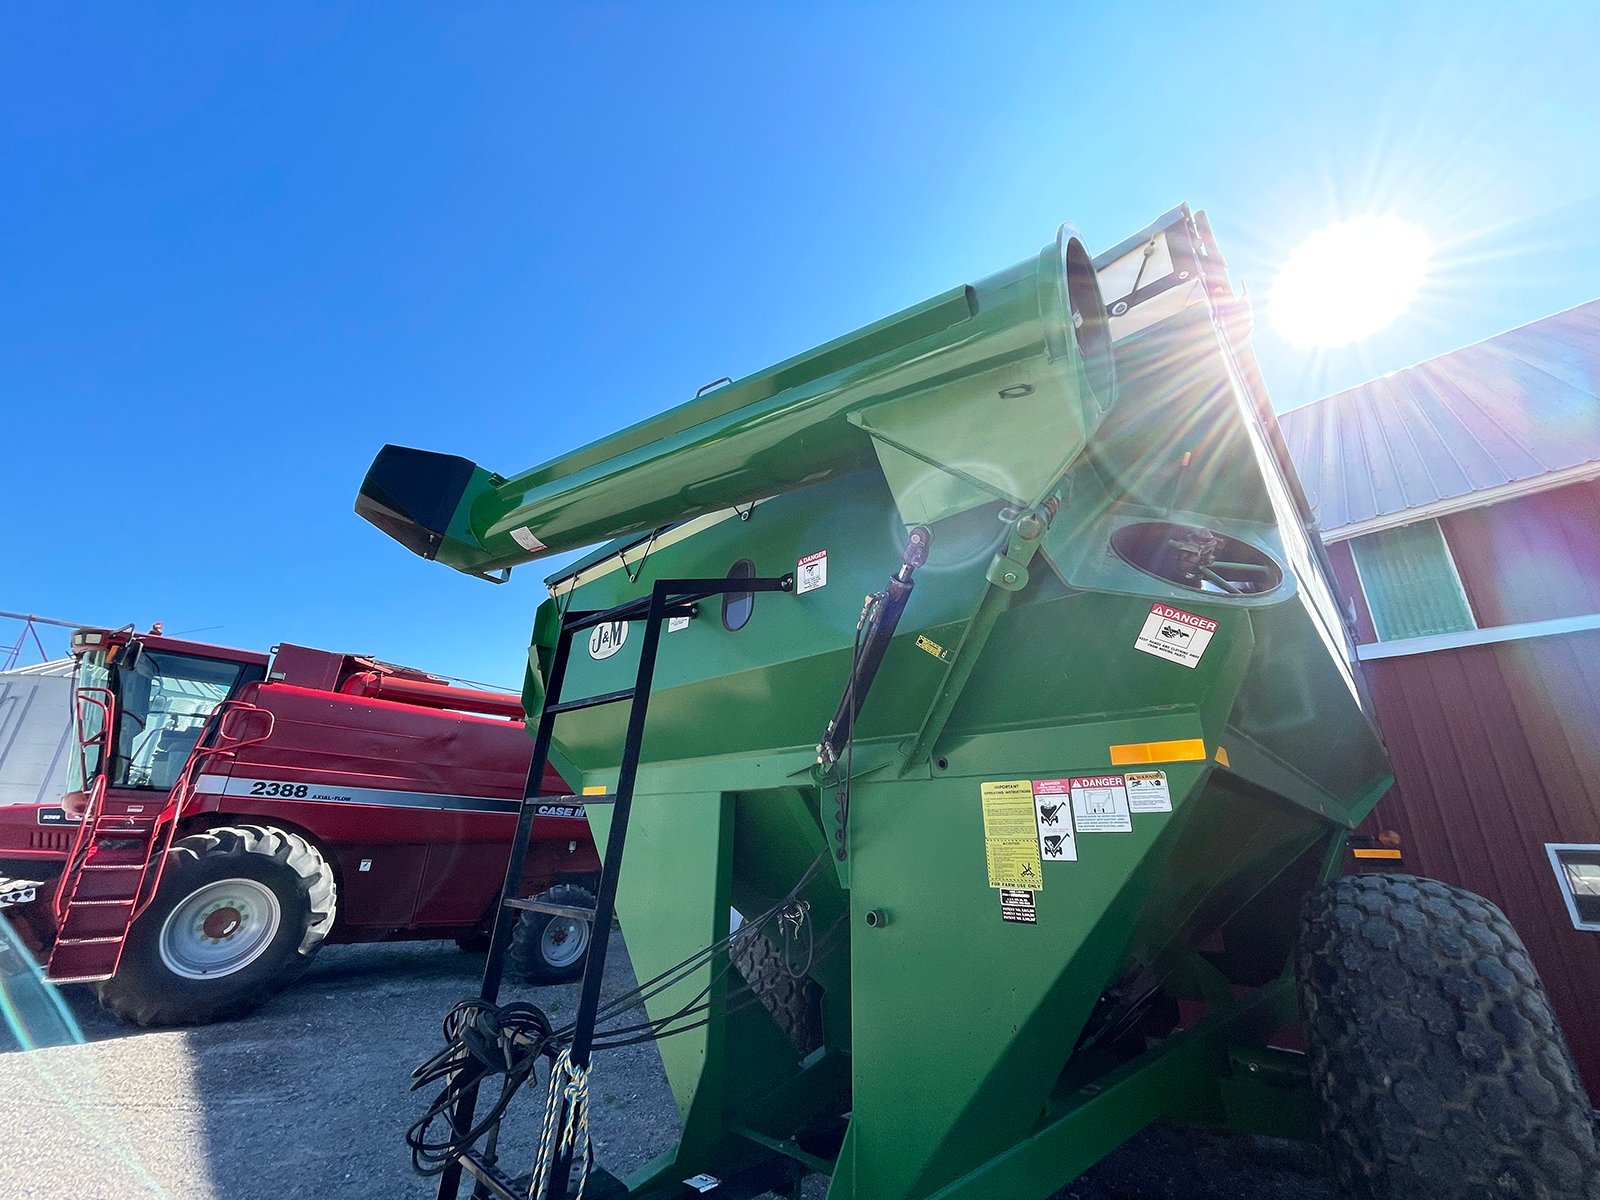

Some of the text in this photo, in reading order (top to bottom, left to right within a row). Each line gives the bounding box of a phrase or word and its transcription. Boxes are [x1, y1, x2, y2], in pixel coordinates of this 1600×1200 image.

[803, 550, 826, 563] DANGER
[1164, 609, 1216, 631] DANGER
[592, 621, 623, 653] J&M
[1082, 778, 1123, 787] DANGER
[250, 782, 308, 798] 2388
[538, 805, 573, 816] CASE
